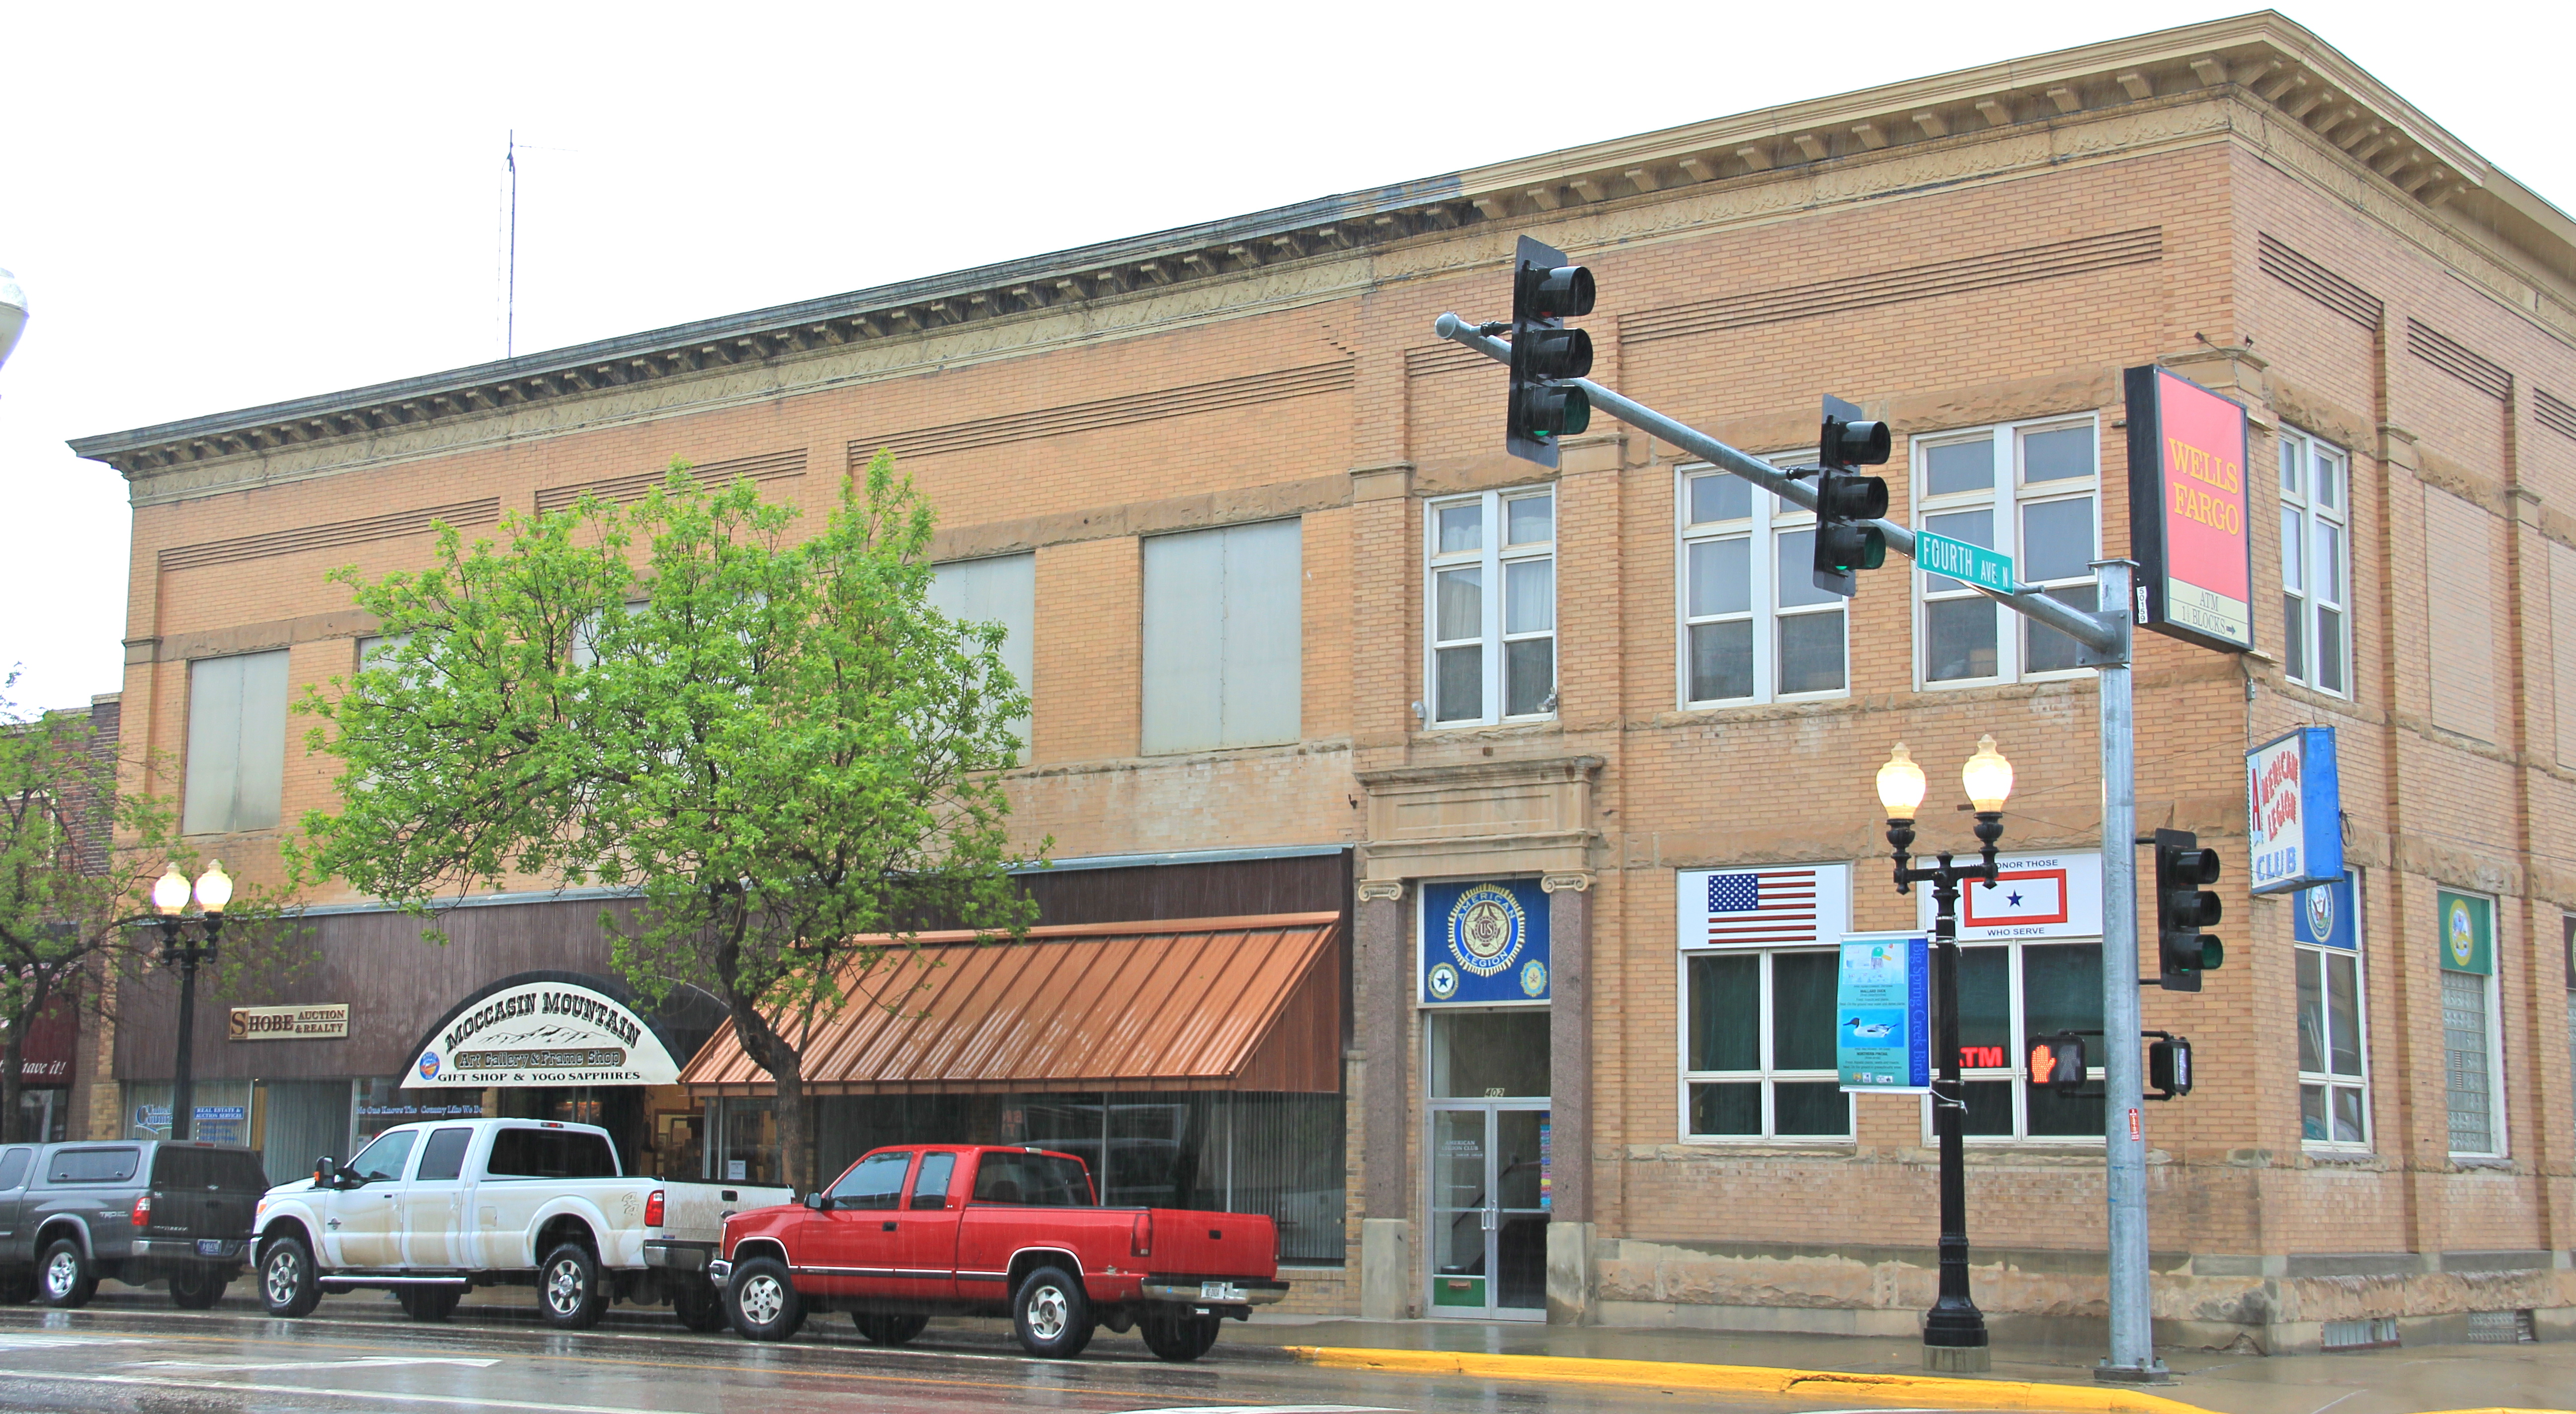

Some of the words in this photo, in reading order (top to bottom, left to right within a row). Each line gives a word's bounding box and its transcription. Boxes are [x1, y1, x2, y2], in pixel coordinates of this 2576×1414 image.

[2168, 437, 2238, 494] WELLS
[2173, 482, 2240, 536] FARGO
[1923, 536, 1973, 577] FOURTH
[1981, 560, 1997, 584] AVE
[2003, 567, 2008, 587] N
[2199, 591, 2219, 611] ATM
[2192, 608, 2226, 634] BLOCKS
[2252, 750, 2298, 831] AMERICAN
[2267, 789, 2296, 841] LEGION
[2256, 846, 2296, 881] CLUB
[1458, 893, 1516, 920] AMERICAN
[1480, 923, 1493, 935] US
[1464, 951, 1508, 966] LEGION
[1910, 944, 1925, 964] Big
[1909, 967, 1926, 1006] Spring
[231, 1011, 294, 1035] SHOBE
[298, 1010, 345, 1020] AUCTION
[445, 993, 537, 1054] MOCCASIN
[543, 992, 642, 1049] MOUNTAIN
[295, 1025, 303, 1033] &
[304, 1023, 343, 1032] REALTY
[1913, 1010, 1927, 1045] Creek
[49, 1061, 67, 1075] it!
[460, 1053, 480, 1066] Art
[484, 1052, 529, 1068] Gallery
[531, 1054, 539, 1065] &
[541, 1051, 583, 1065] Frame
[588, 1050, 620, 1067] Shop
[1914, 1051, 1927, 1082] Birds
[1959, 1047, 2003, 1067] TM
[472, 1073, 507, 1081] SHOP
[568, 1072, 641, 1080] SAPPHIRES
[1486, 1088, 1502, 1097] 402
[420, 1105, 447, 1116] Country
[448, 1105, 462, 1113] Like
[463, 1105, 473, 1113] We
